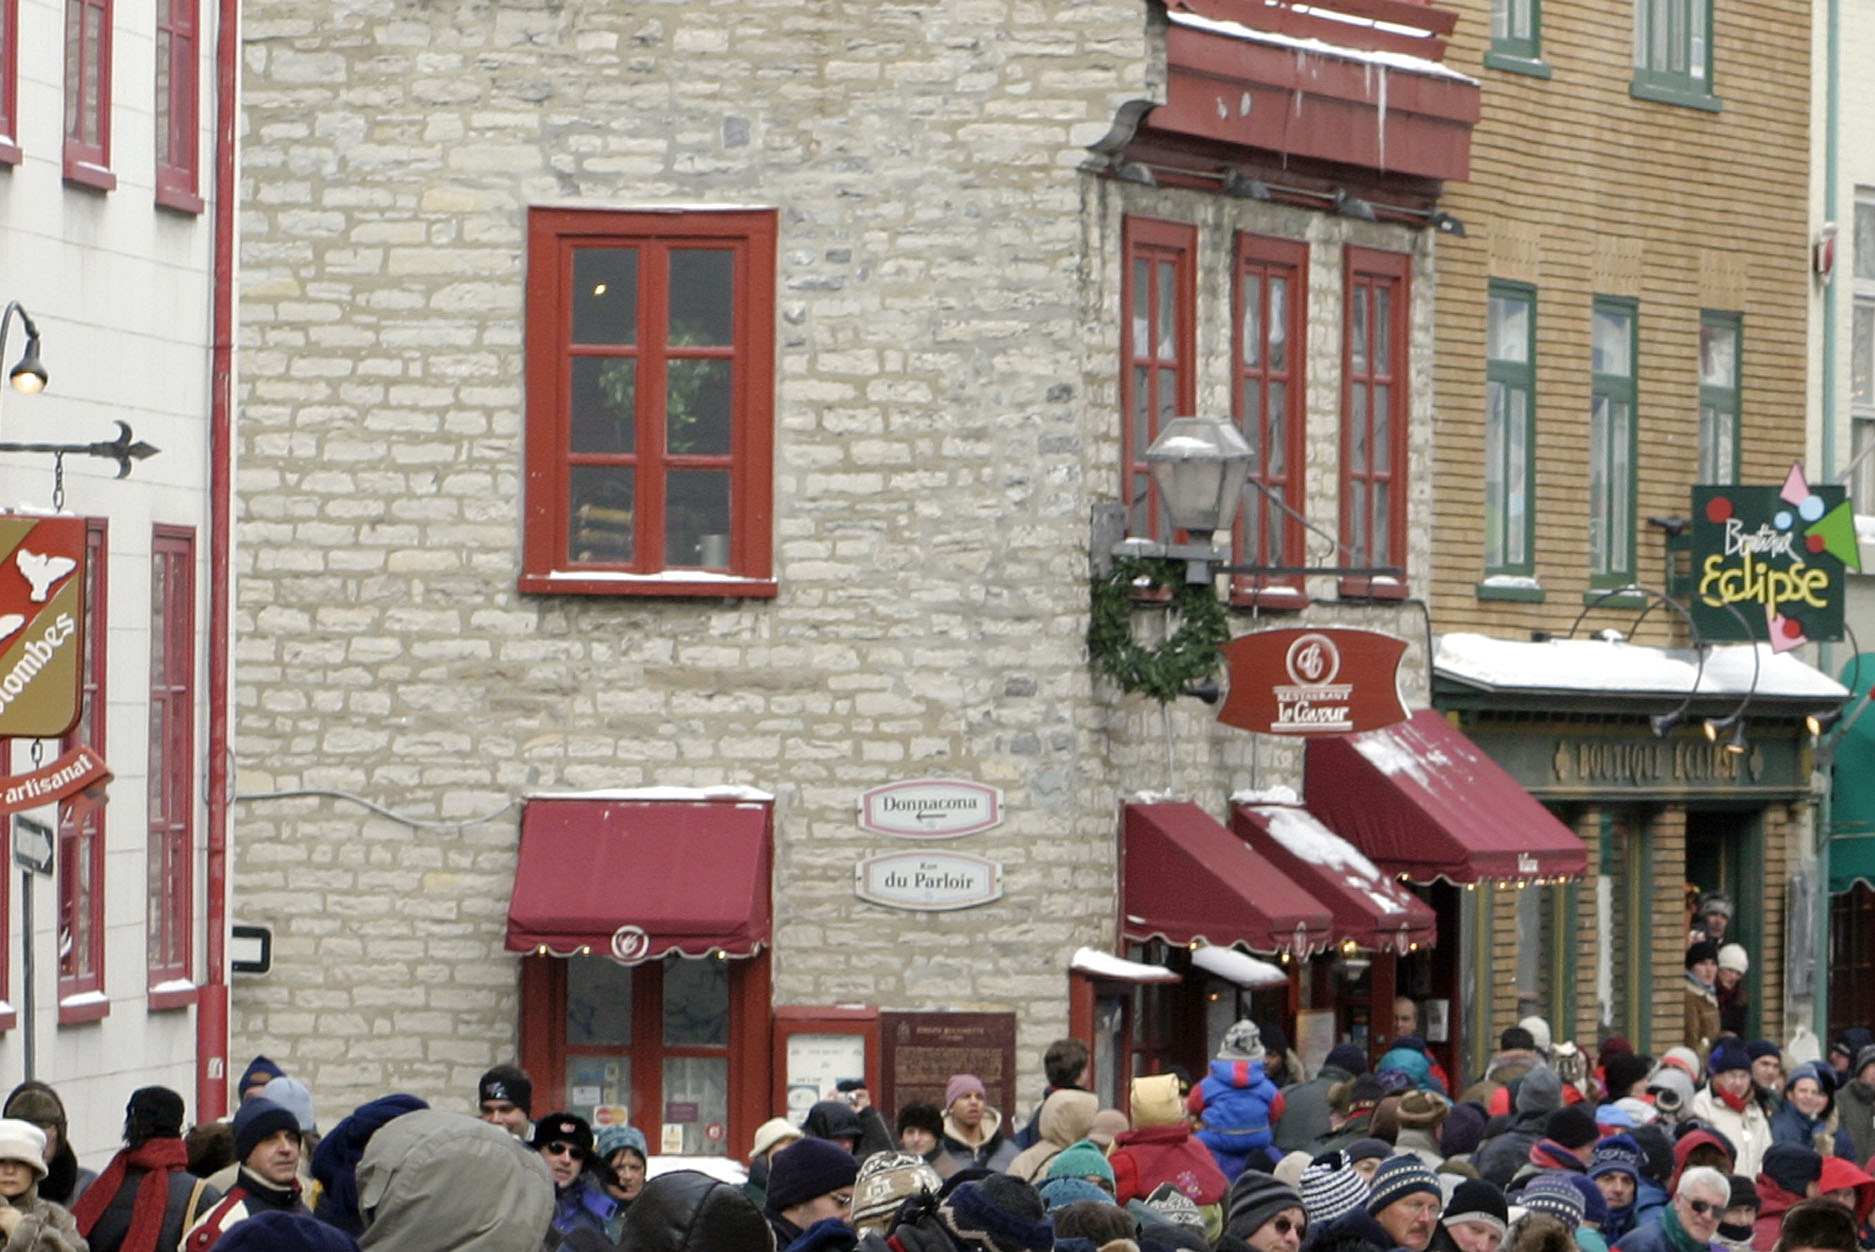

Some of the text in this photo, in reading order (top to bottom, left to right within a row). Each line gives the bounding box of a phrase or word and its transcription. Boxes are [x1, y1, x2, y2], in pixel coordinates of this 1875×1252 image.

[5, 752, 94, 804] artisanat
[882, 796, 978, 812] Donnacona
[884, 872, 974, 889] du Parloir
